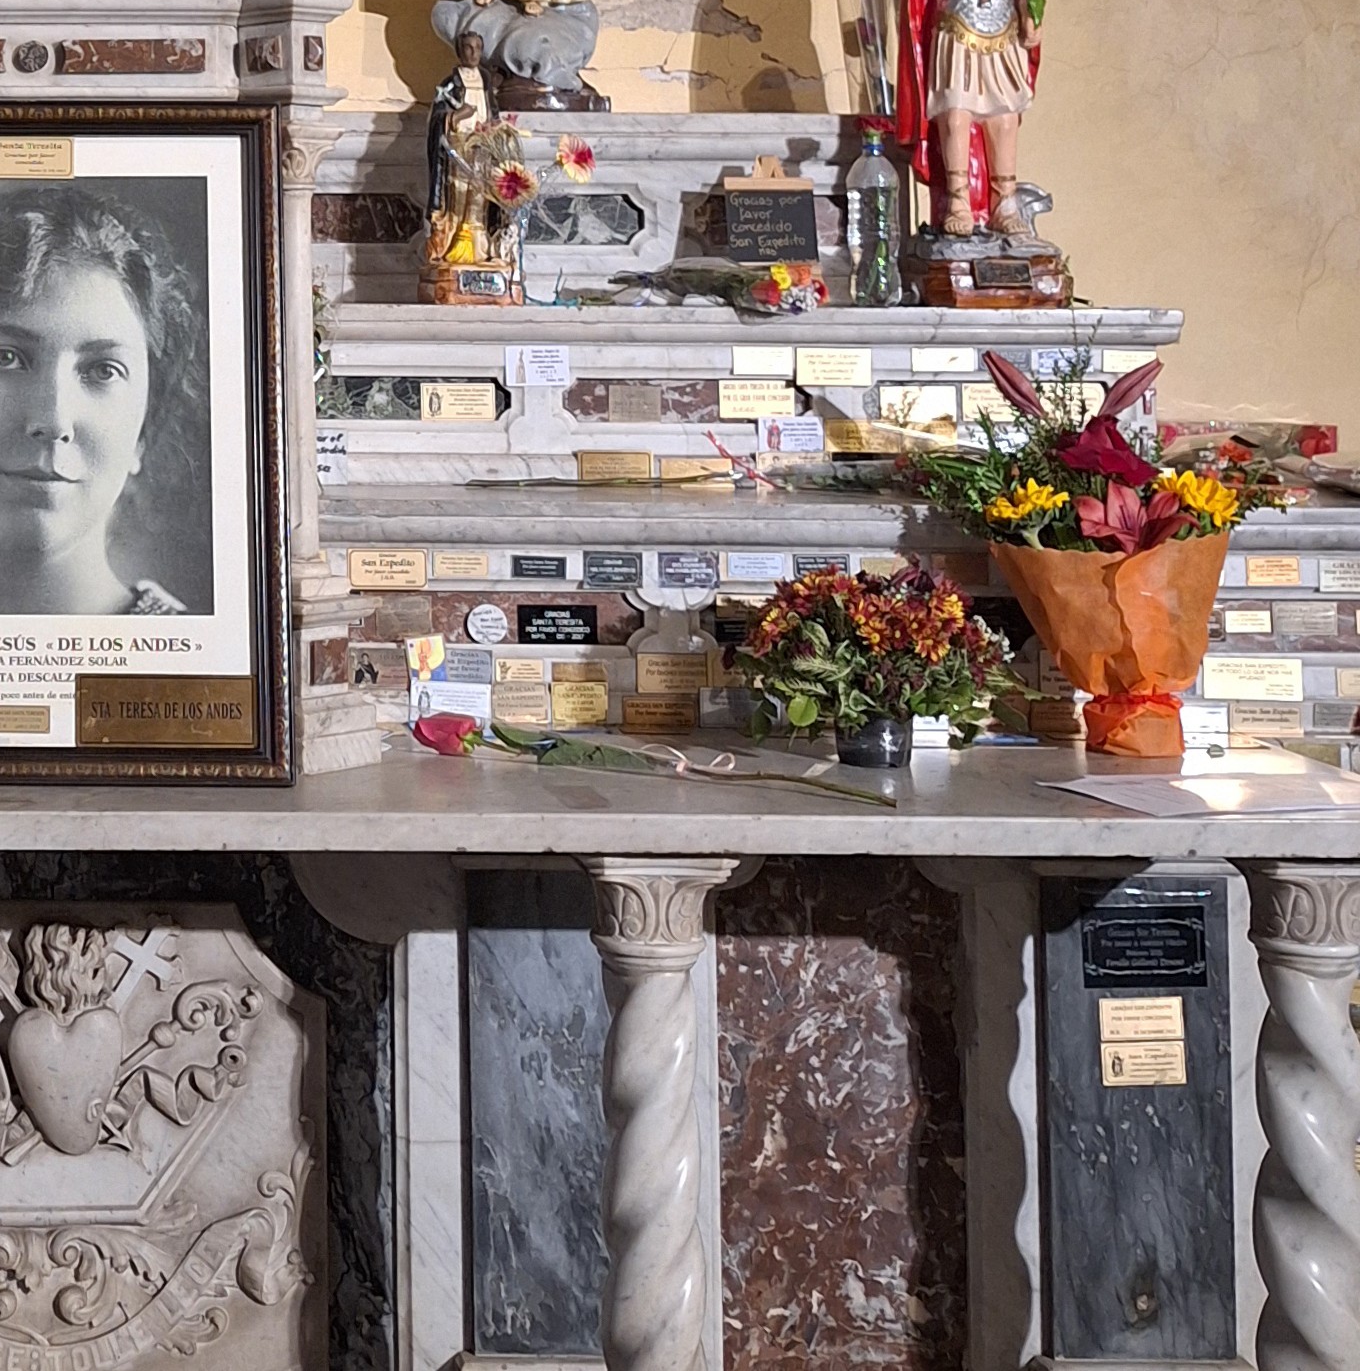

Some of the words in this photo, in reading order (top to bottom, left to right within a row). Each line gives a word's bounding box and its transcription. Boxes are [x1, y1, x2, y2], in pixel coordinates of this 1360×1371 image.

[730, 192, 773, 206] Gracias
[779, 197, 802, 206] por
[731, 220, 792, 233] concedido
[730, 235, 752, 248] San
[758, 234, 805, 249] Expedito
[57, 637, 83, 652] DE
[89, 637, 123, 652] LOS
[129, 638, 192, 652] ANDES
[9, 654, 84, 666] FERNÁNDEZ
[88, 656, 128, 667] SOLAR
[18, 672, 76, 682] DESCALZ
[47, 691, 57, 699] de
[119, 701, 161, 719] TERESA
[164, 701, 178, 719] DE
[183, 701, 203, 720] LOS
[206, 702, 243, 719] ANDES
